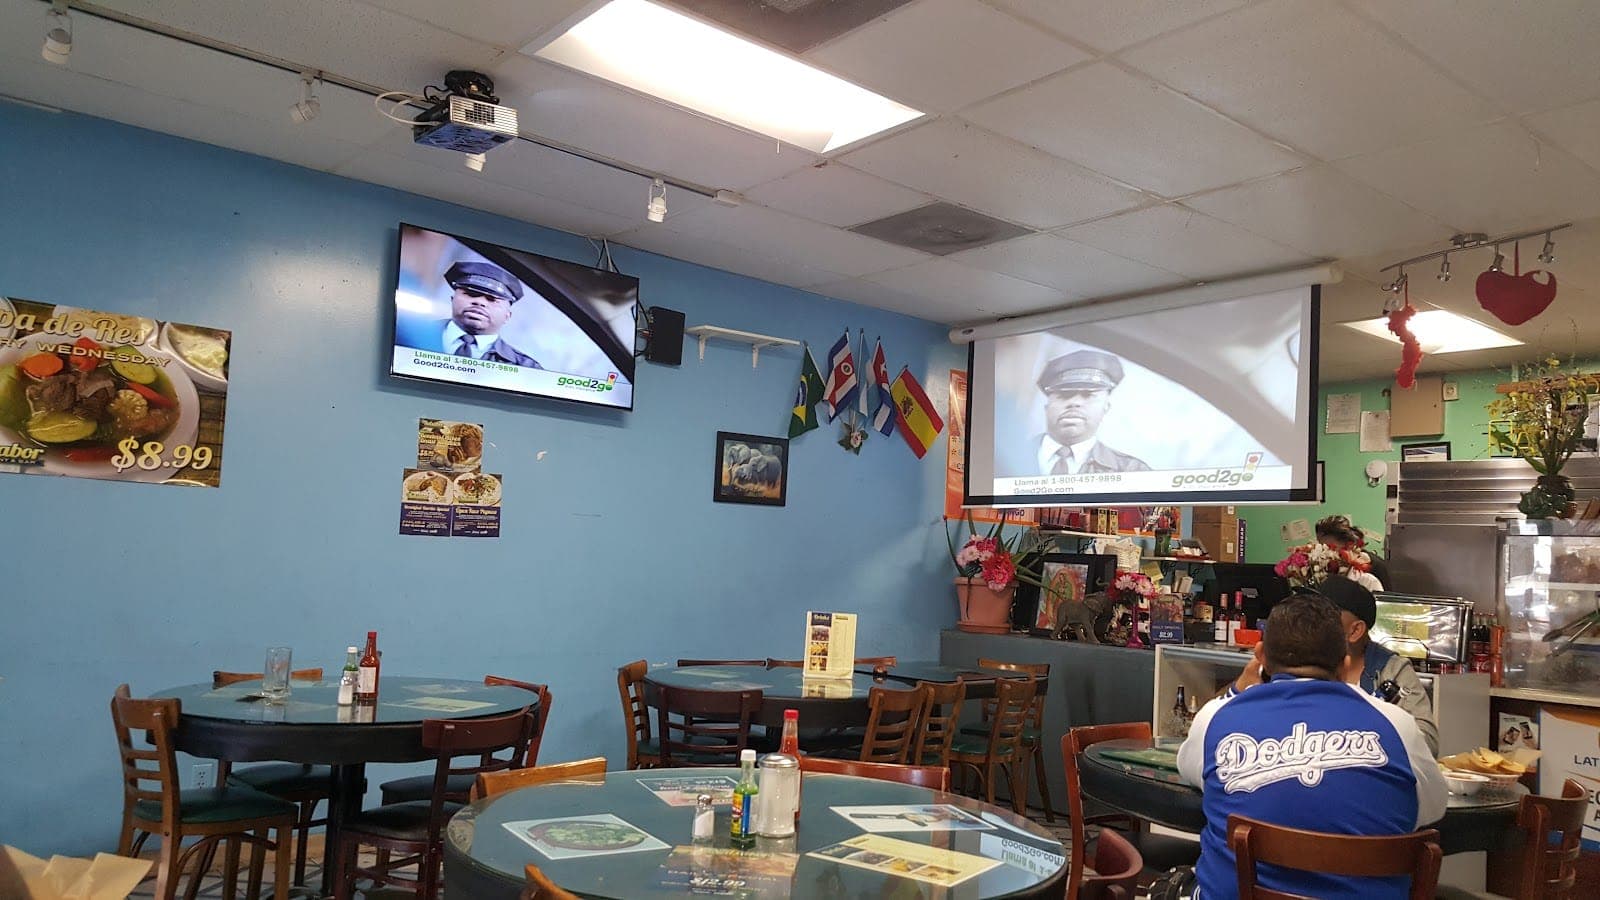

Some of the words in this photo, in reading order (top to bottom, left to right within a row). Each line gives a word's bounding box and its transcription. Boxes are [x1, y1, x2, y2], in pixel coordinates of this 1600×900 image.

[43, 313, 84, 338] de
[92, 318, 147, 347] Res
[37, 341, 170, 367] WEDNESDAY
[413, 358, 476, 374] Good2Go.com
[557, 377, 613, 392] good2go
[111, 436, 213, 472] $8.99
[1171, 469, 1254, 488] good2go
[1214, 722, 1388, 794] Dodgers
